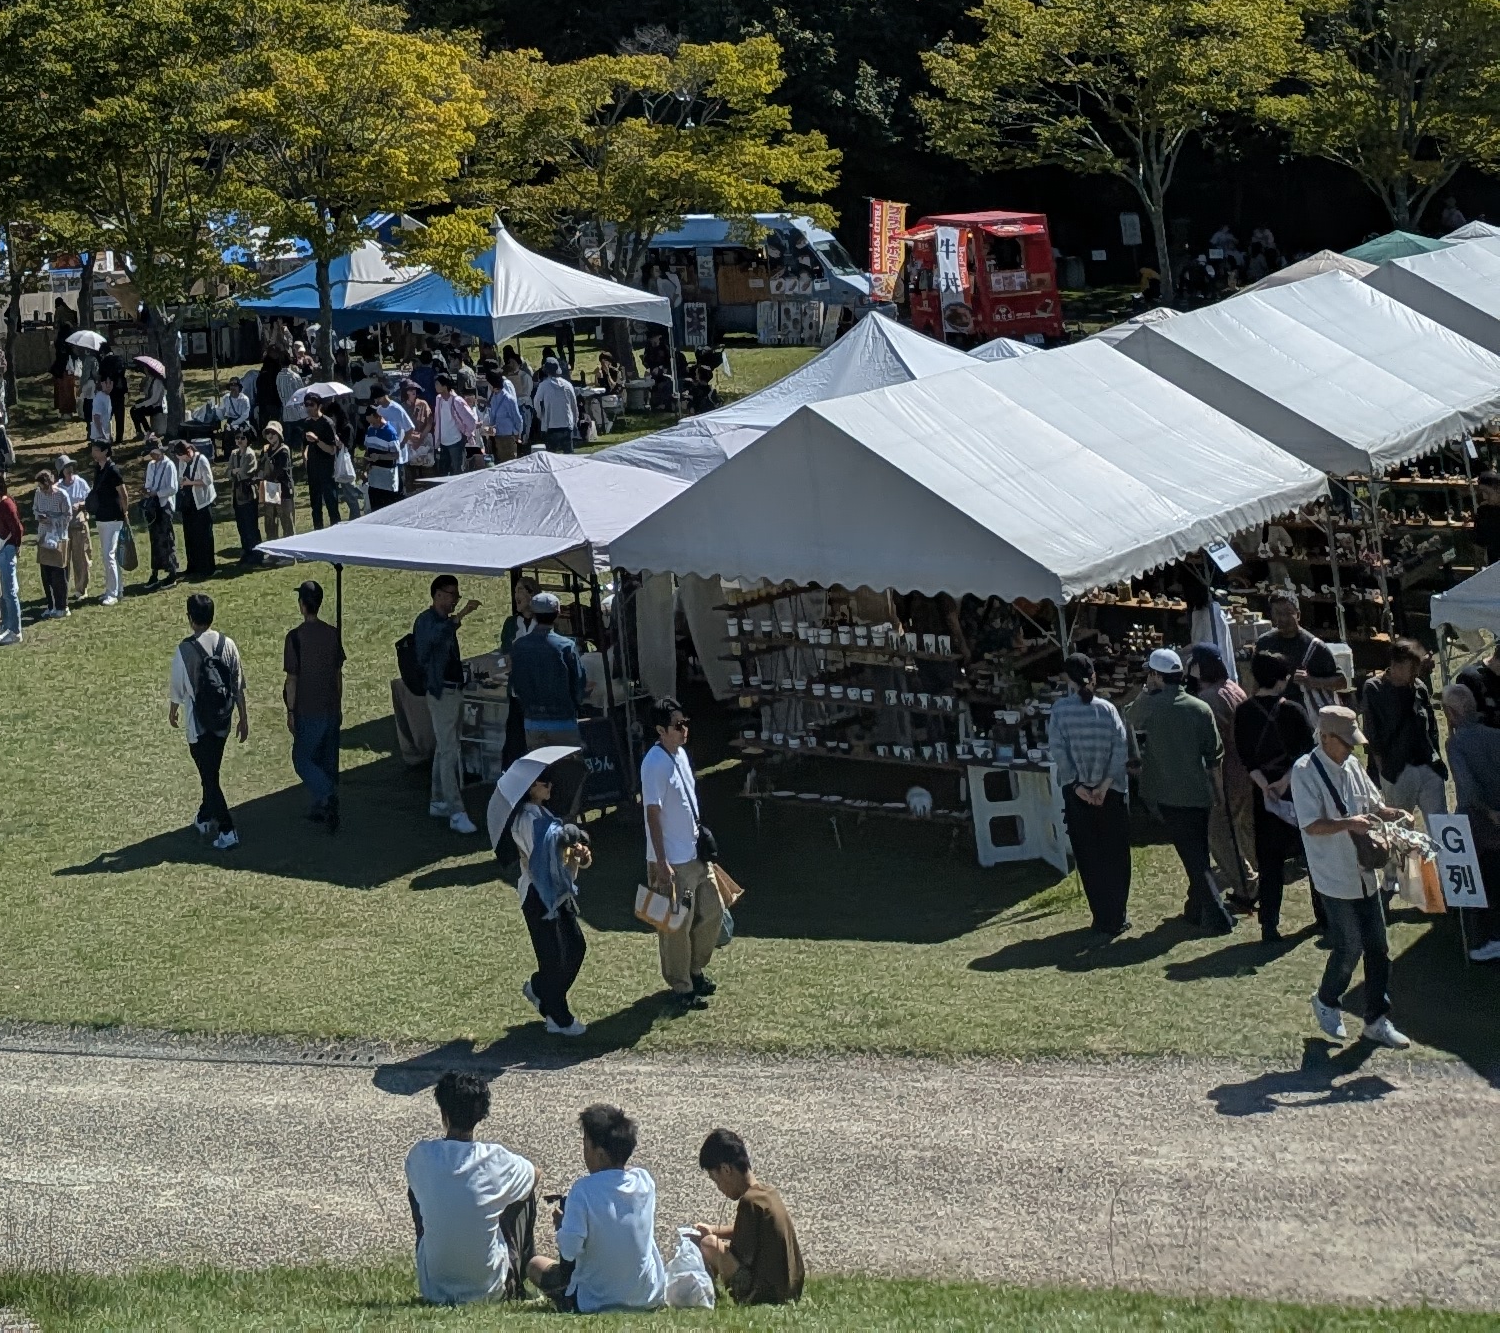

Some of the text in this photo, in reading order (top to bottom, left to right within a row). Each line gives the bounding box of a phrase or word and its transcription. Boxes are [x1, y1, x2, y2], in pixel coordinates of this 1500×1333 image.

[873, 234, 881, 271] POTATO
[939, 237, 960, 293] 牛丼
[959, 246, 967, 266] Beef
